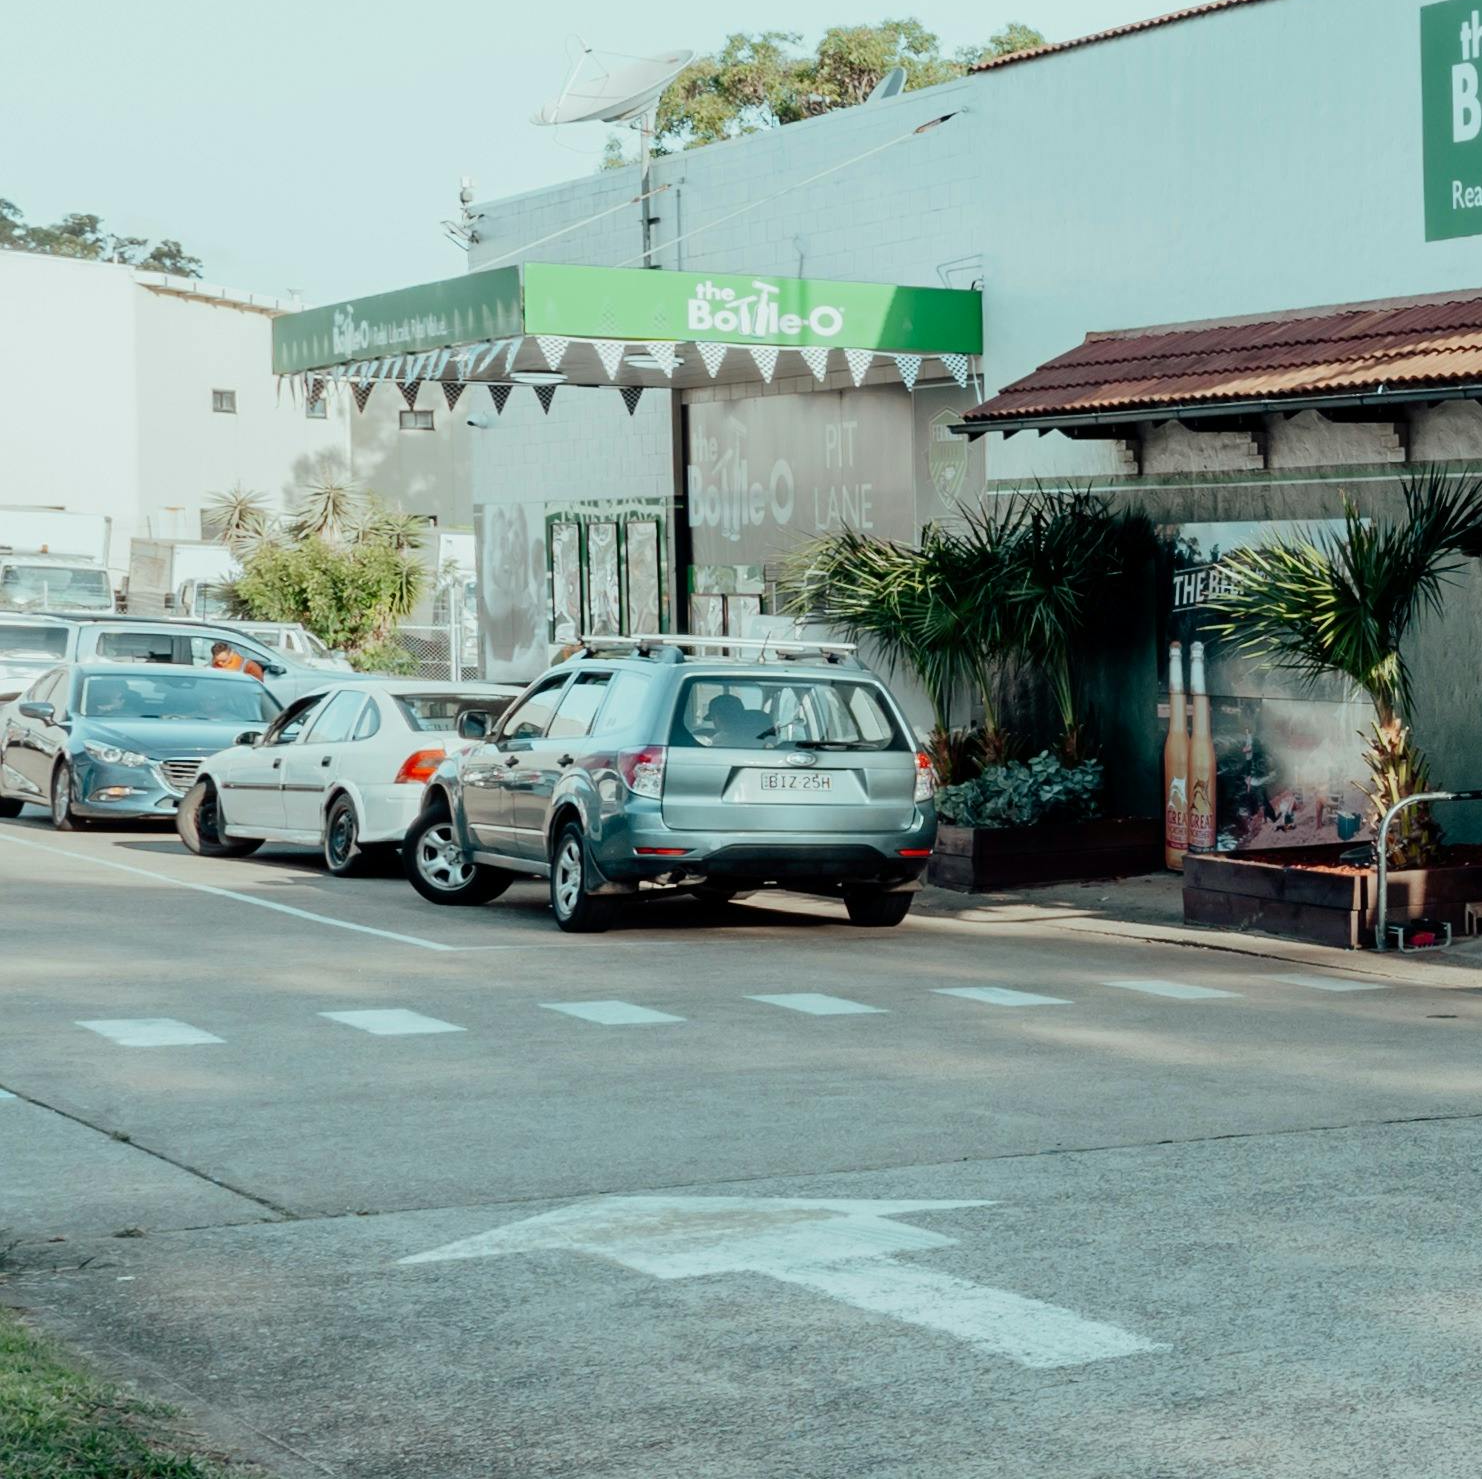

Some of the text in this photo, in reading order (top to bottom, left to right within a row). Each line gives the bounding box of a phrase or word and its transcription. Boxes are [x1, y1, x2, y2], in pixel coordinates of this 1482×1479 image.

[688, 279, 844, 339] Bottle-O
[696, 280, 736, 301] the
[824, 422, 858, 469] PIT
[813, 483, 875, 530] LANE
[1174, 572, 1207, 607] THE
